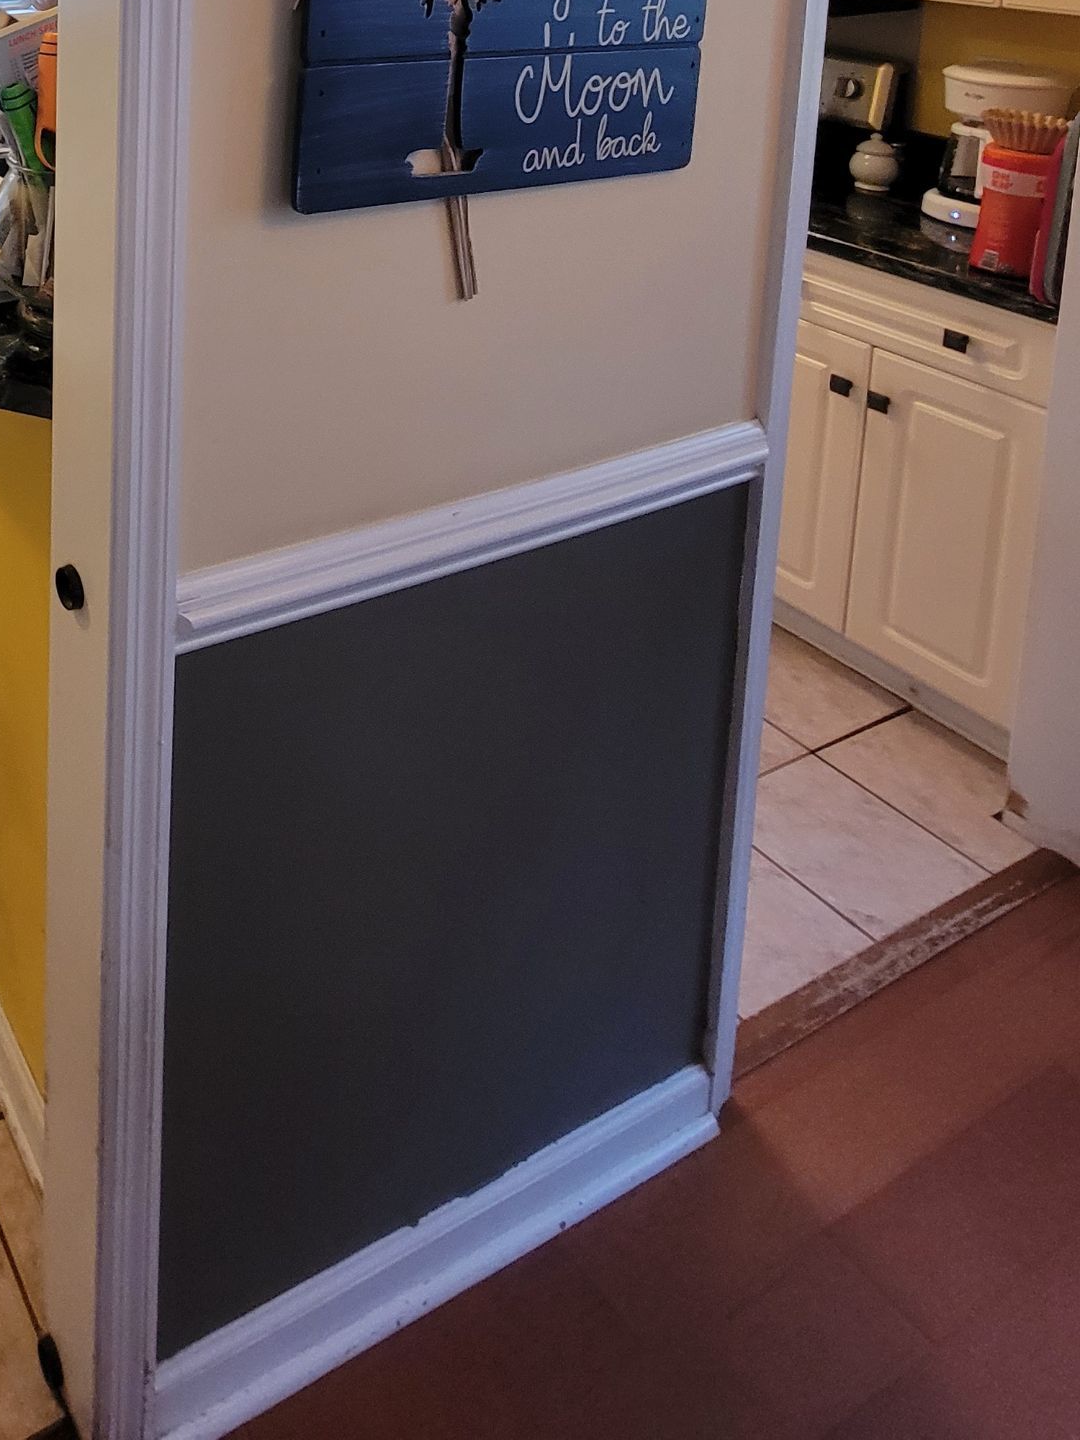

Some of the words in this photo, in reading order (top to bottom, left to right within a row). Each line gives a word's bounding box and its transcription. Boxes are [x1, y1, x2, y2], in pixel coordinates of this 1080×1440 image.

[515, 21, 674, 125] Moon
[522, 118, 587, 173] and
[596, 110, 662, 160] back
